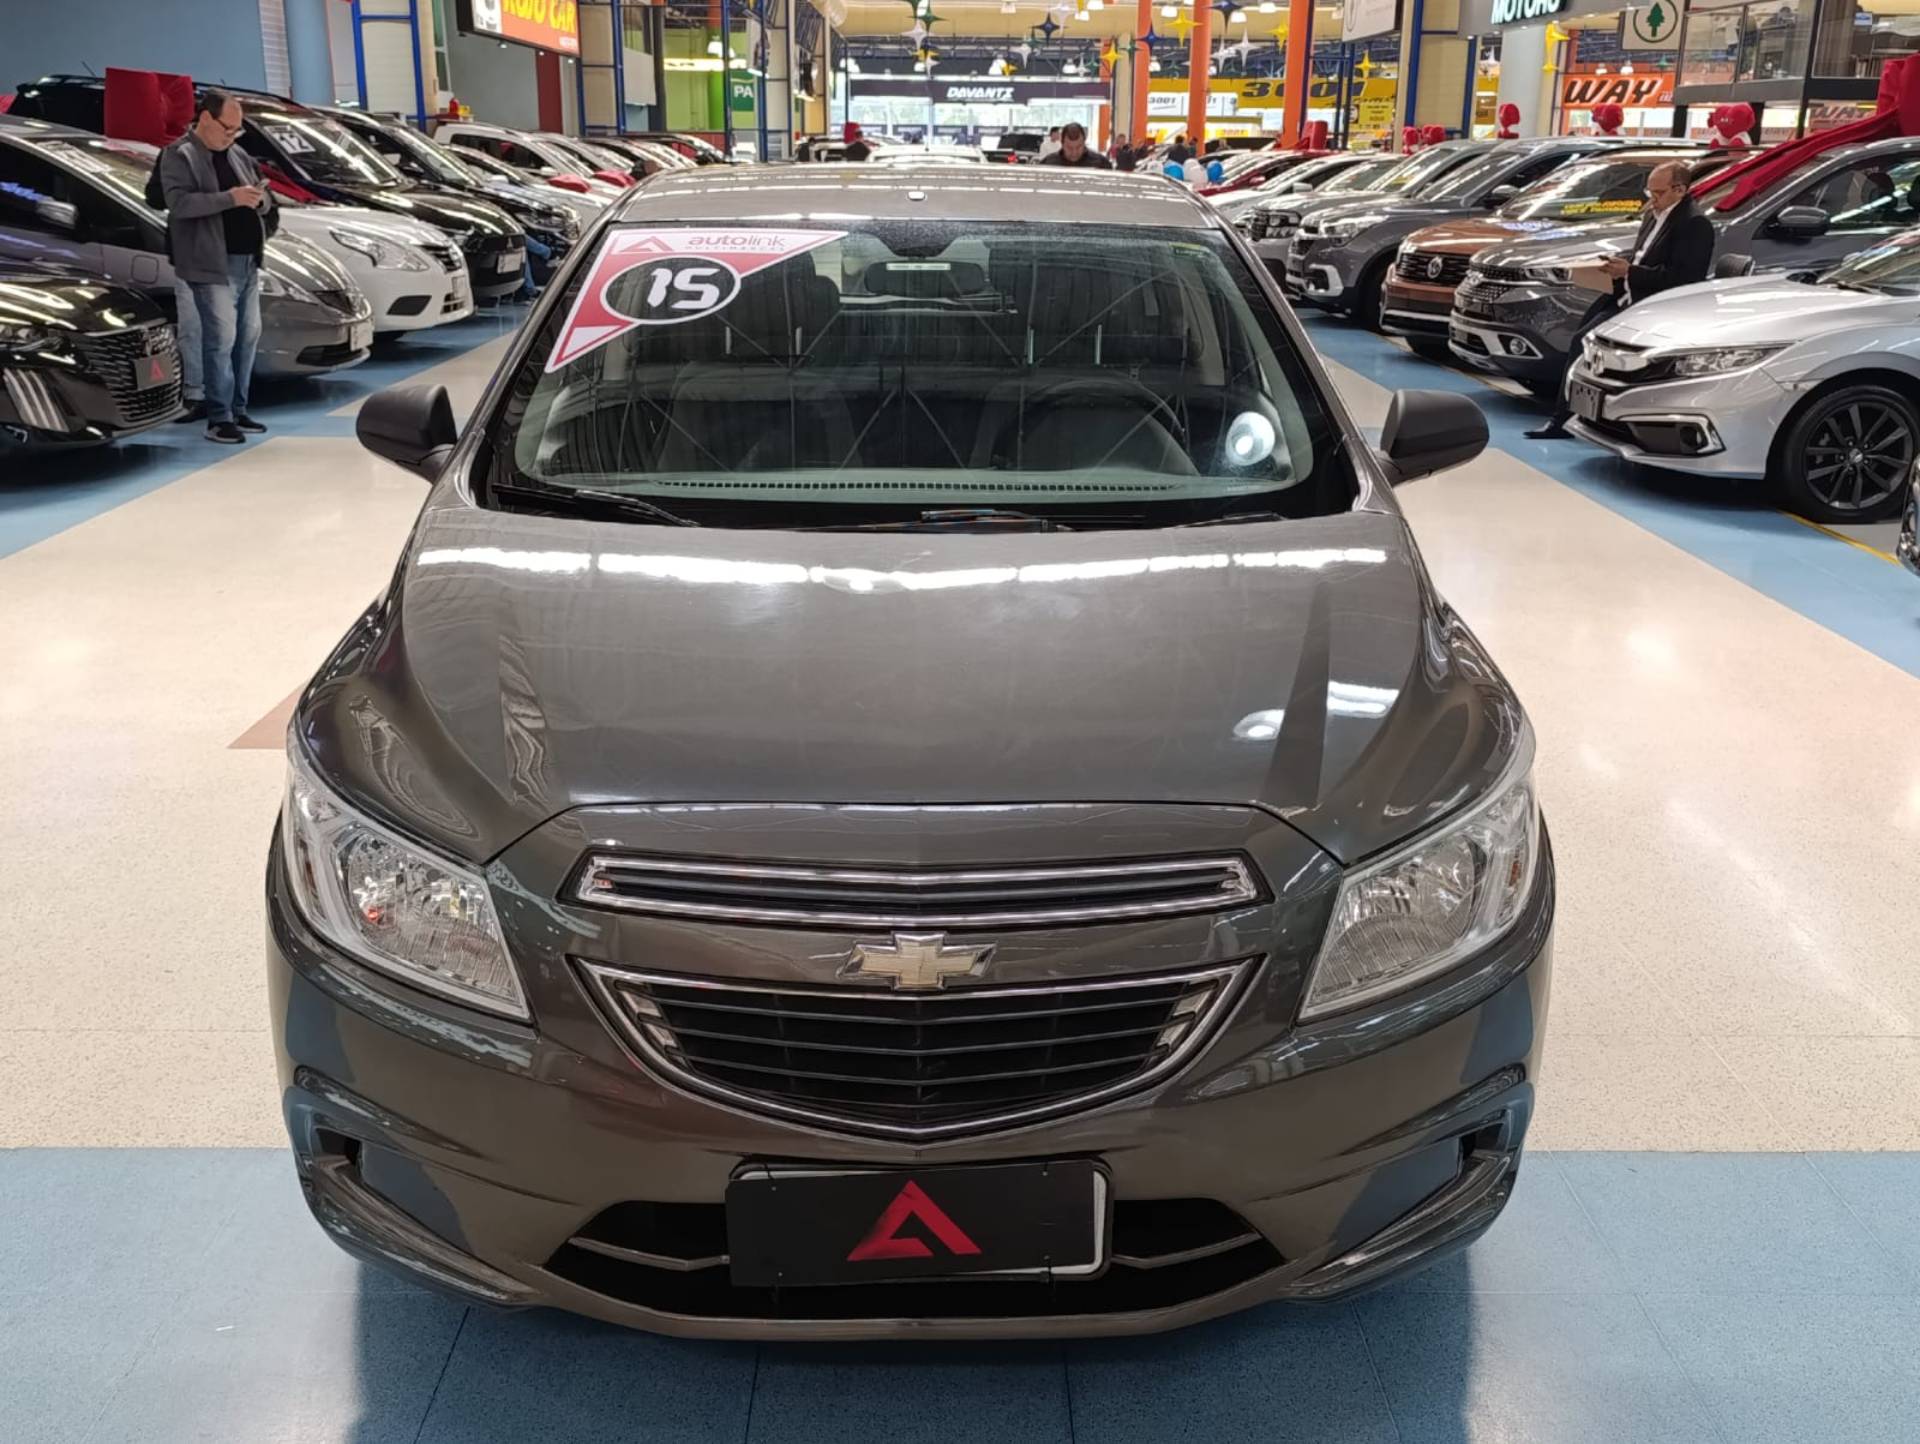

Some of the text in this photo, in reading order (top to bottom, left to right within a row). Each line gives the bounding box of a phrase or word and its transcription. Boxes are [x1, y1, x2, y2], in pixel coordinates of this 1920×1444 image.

[1564, 79, 1661, 104] WAY
[688, 235, 786, 247] autolink
[647, 268, 721, 310] 15
